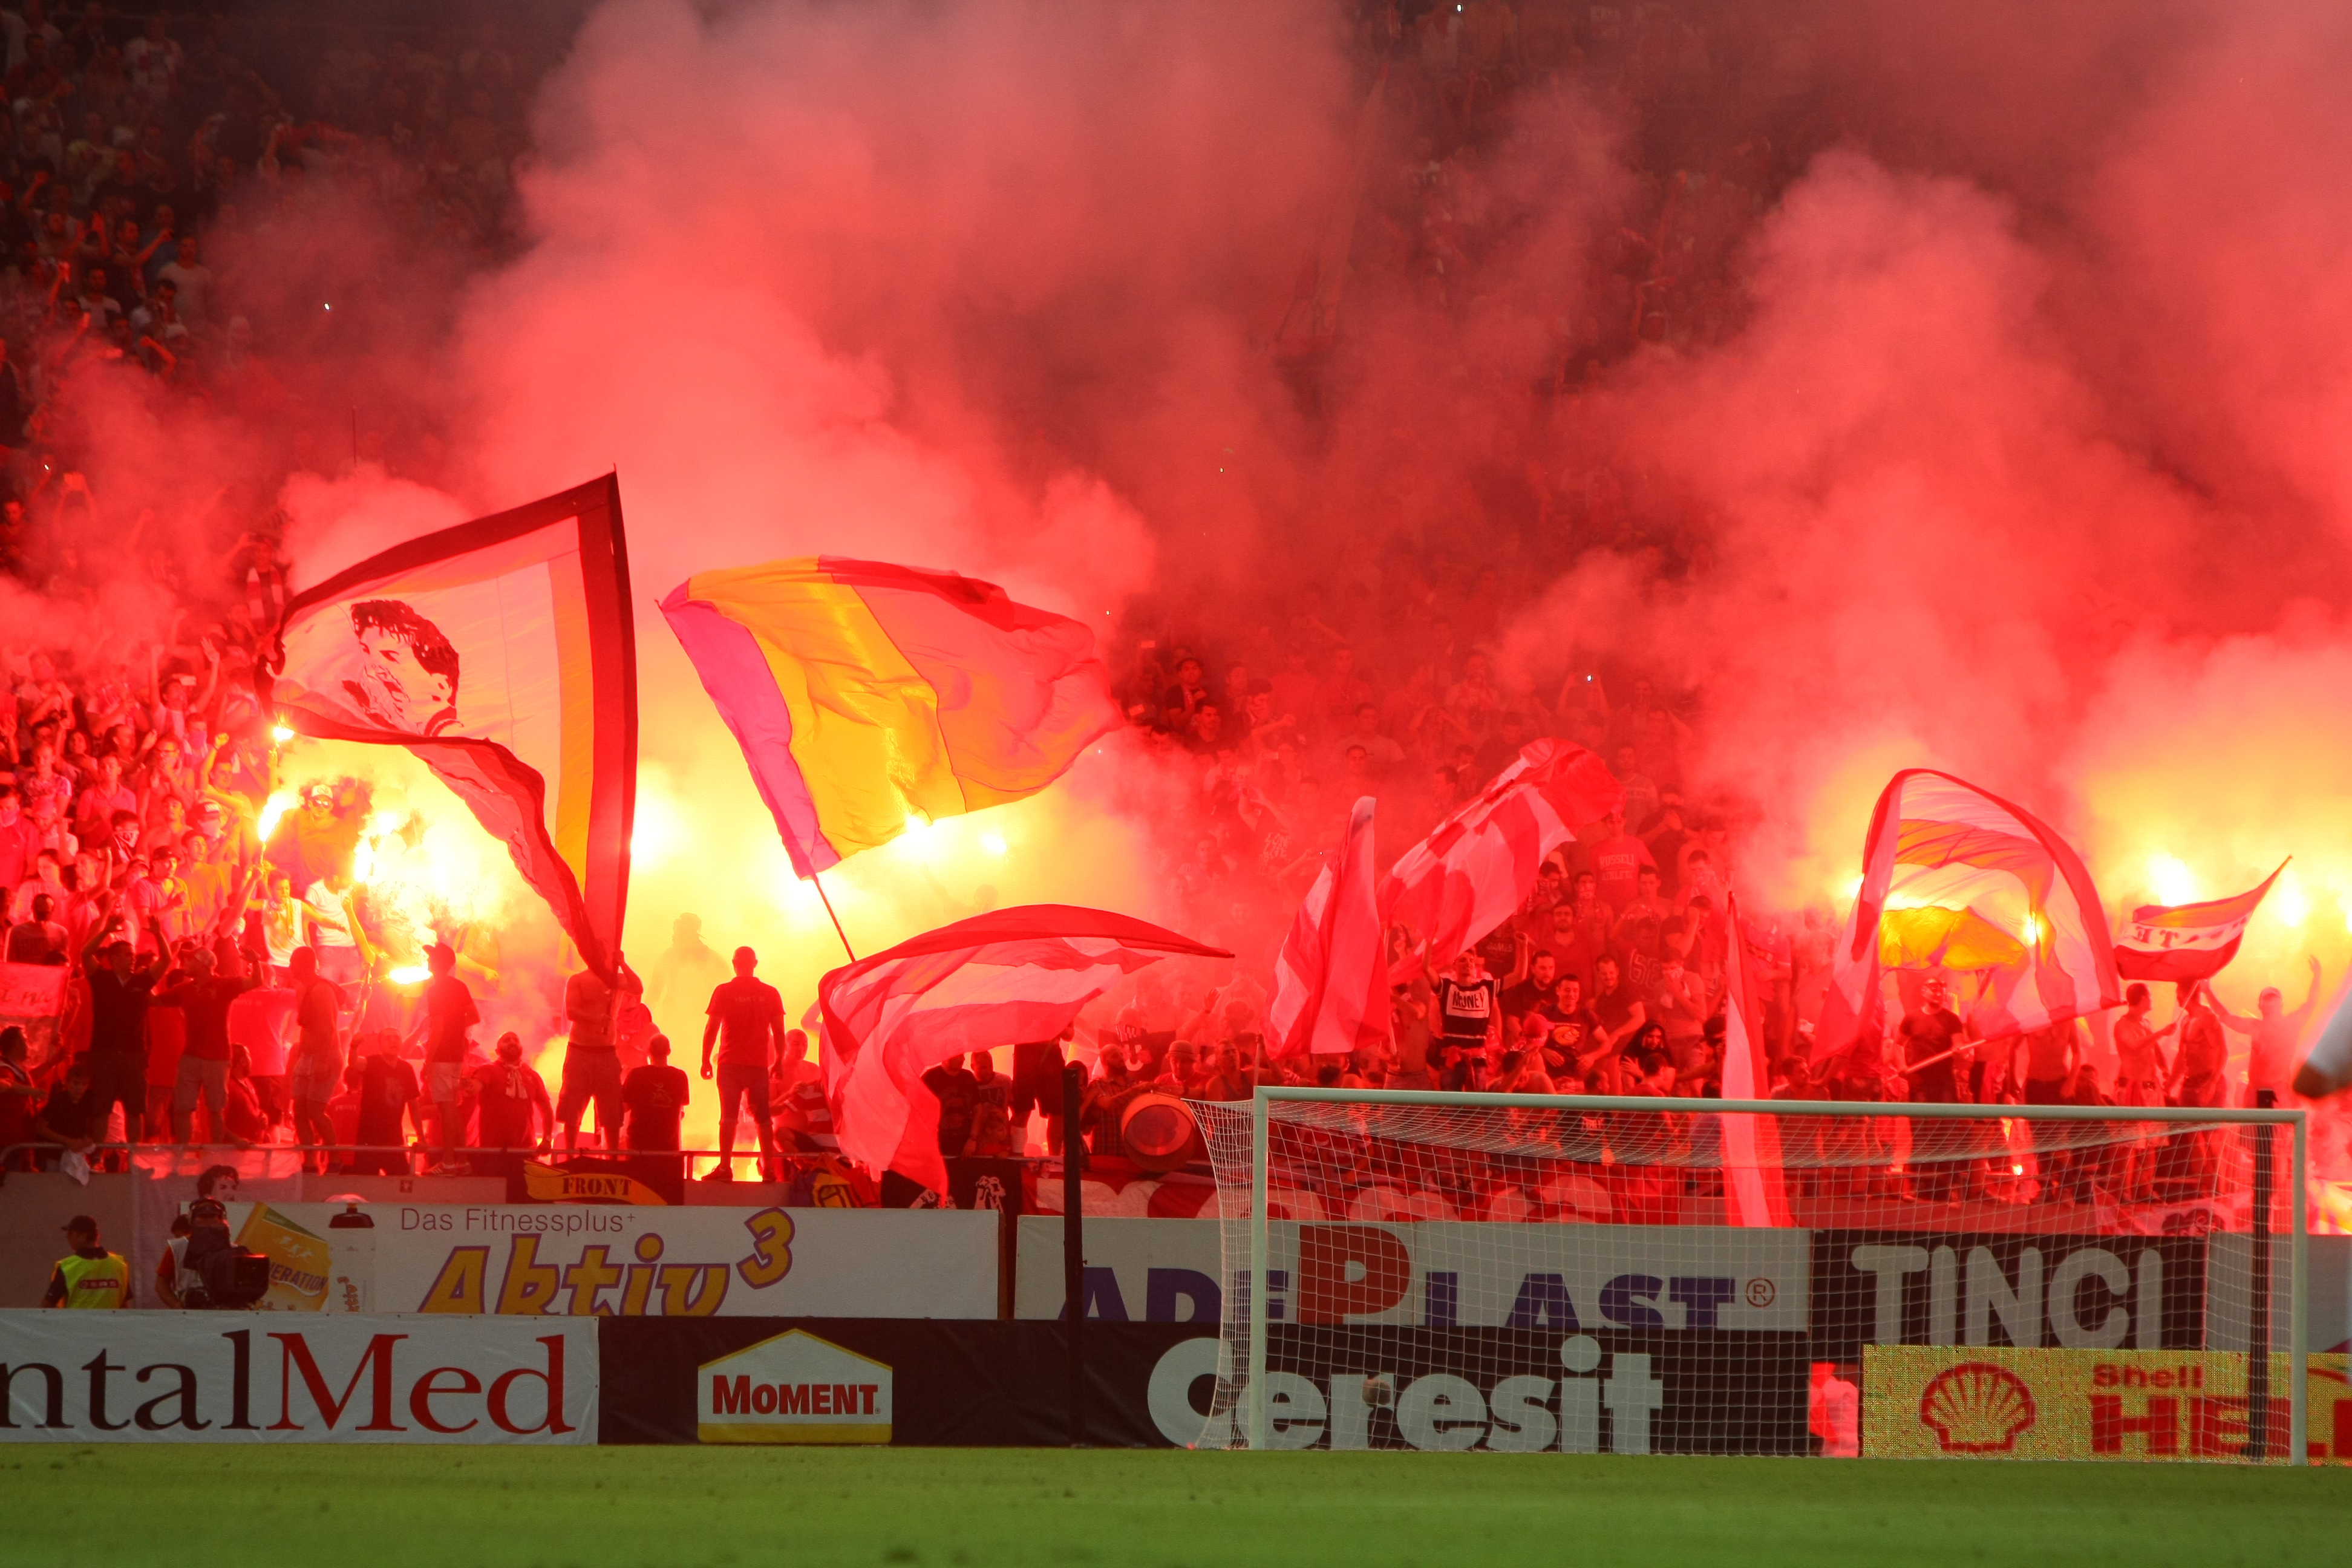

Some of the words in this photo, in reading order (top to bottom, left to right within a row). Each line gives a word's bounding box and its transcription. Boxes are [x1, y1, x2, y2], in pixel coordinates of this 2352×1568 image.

[562, 1177, 632, 1196] FRONT
[400, 1207, 453, 1230] Das
[2093, 1362, 2203, 1388] Shell
[713, 1374, 878, 1415] MOMENT
[1148, 1334, 1664, 1454] Ceresit
